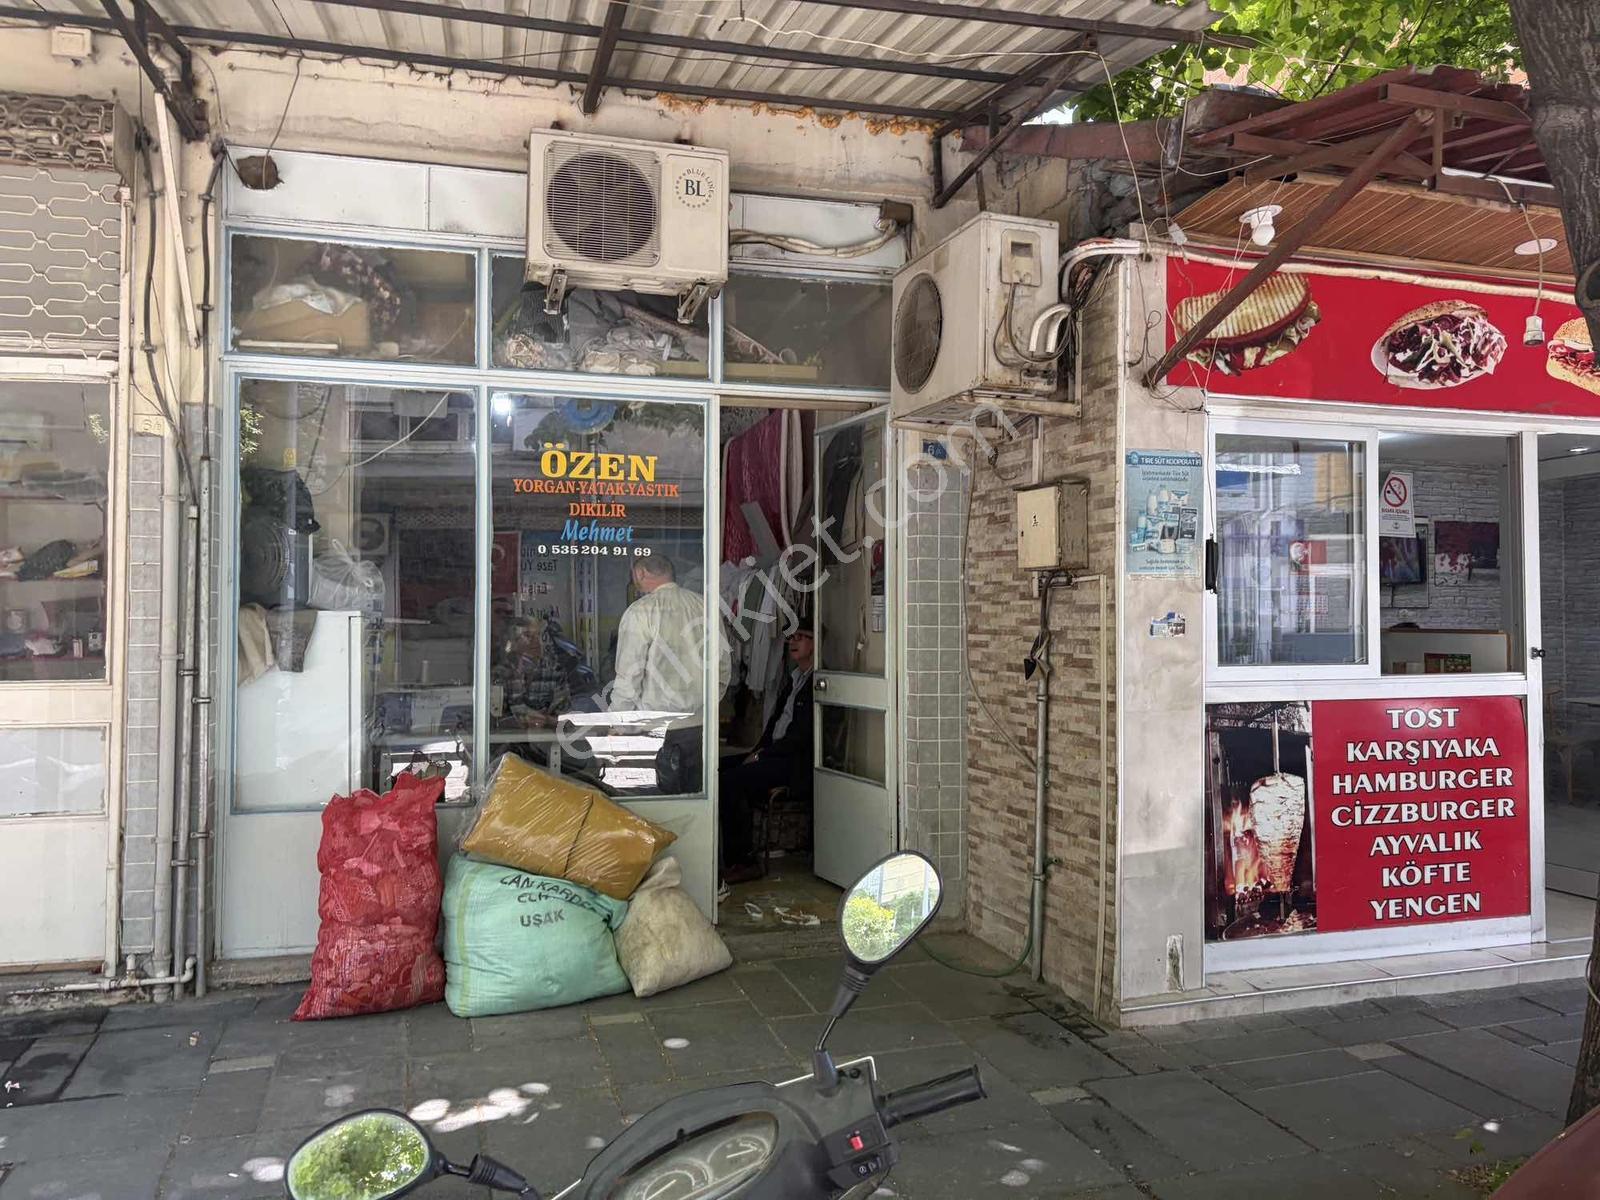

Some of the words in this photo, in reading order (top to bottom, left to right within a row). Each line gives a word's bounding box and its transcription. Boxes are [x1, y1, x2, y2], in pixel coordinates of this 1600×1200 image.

[684, 179, 706, 197] BL
[541, 442, 658, 482] ÖZEN
[569, 499, 627, 517] DİKİLİR
[560, 520, 634, 542] Mehmet
[537, 545, 546, 554] 0
[551, 545, 579, 555] 535
[613, 546, 628, 556] 91
[633, 547, 651, 557] 69
[1387, 708, 1460, 729] TOST
[1347, 737, 1500, 765] KARŞIYAKA
[1332, 767, 1514, 795] HAMBURGER
[1331, 799, 1516, 827] CİZZBURGER
[1370, 831, 1483, 857] AYVALIK
[1382, 860, 1472, 888] KÖFTE
[1370, 892, 1481, 920] YENGEN
